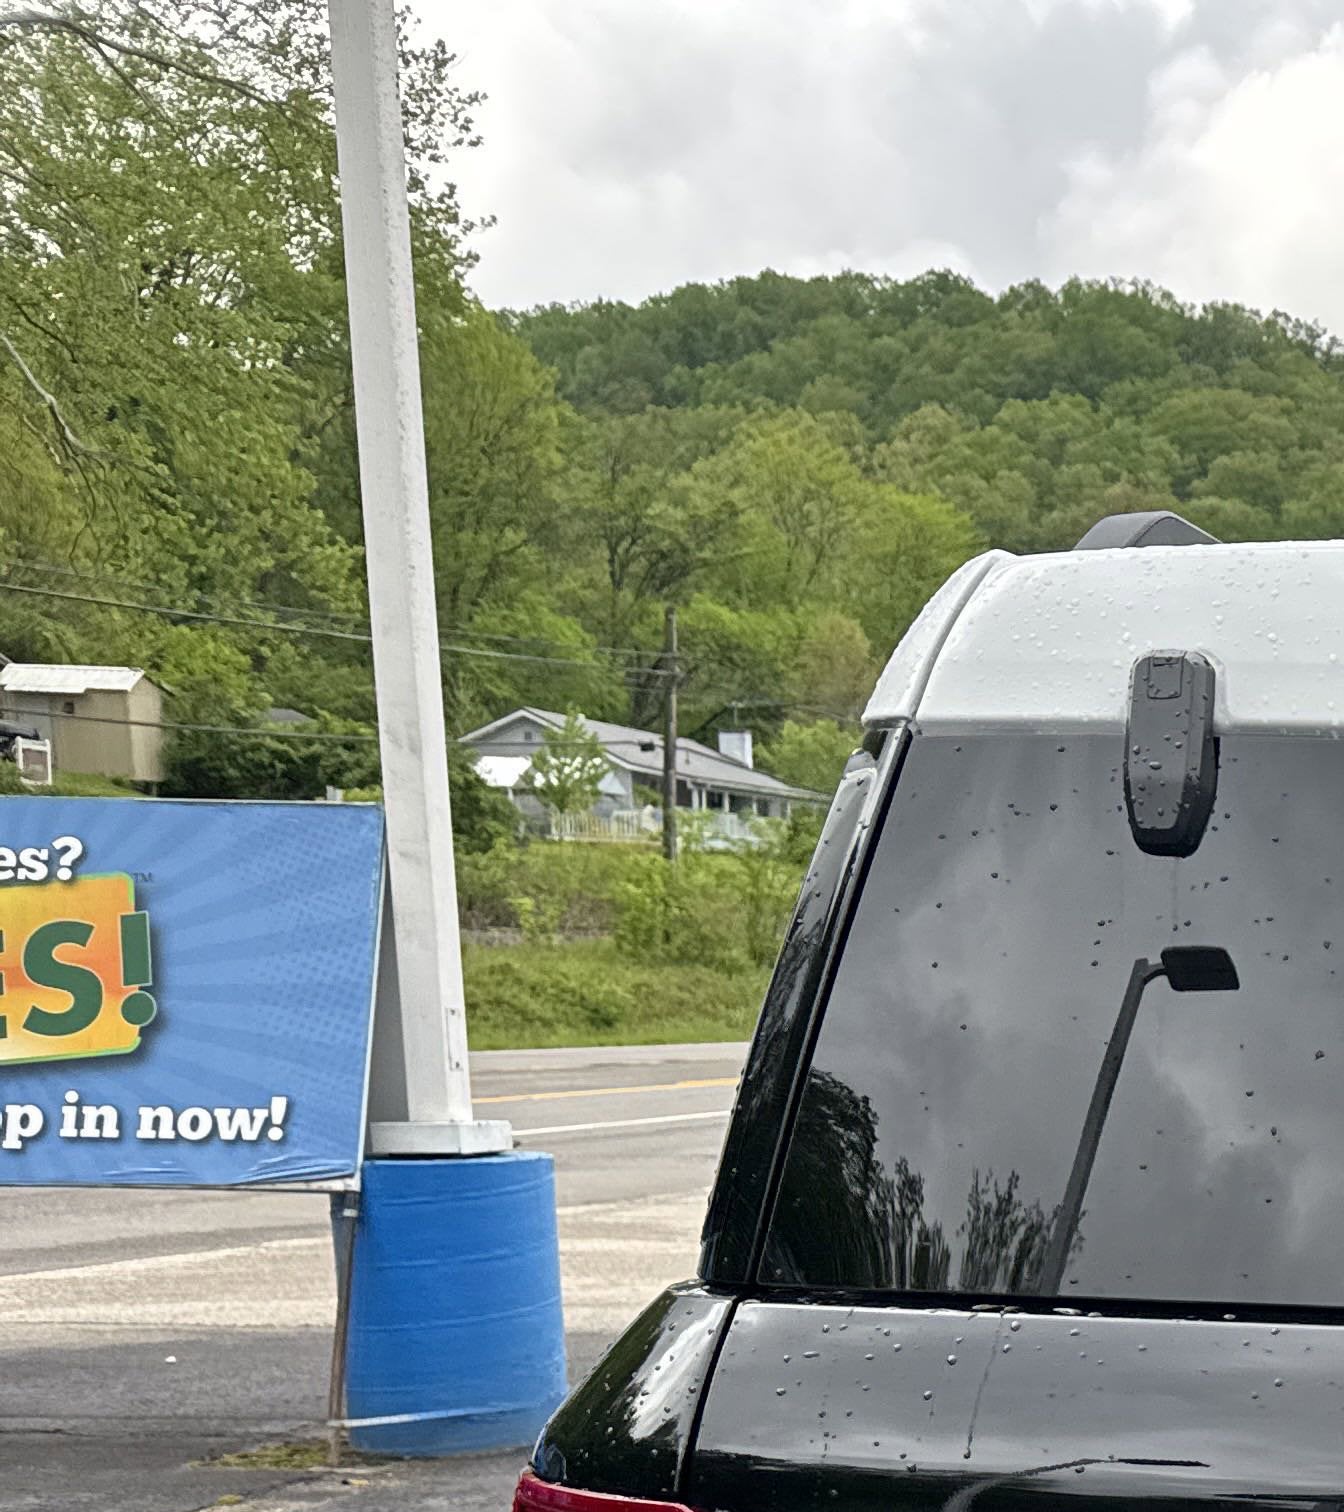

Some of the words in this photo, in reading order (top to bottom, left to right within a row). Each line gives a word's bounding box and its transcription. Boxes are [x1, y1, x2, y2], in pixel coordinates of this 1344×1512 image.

[0, 911, 157, 1038] S!
[0, 1104, 44, 1149] p
[59, 1090, 120, 1139] in
[136, 1096, 288, 1141] now!
